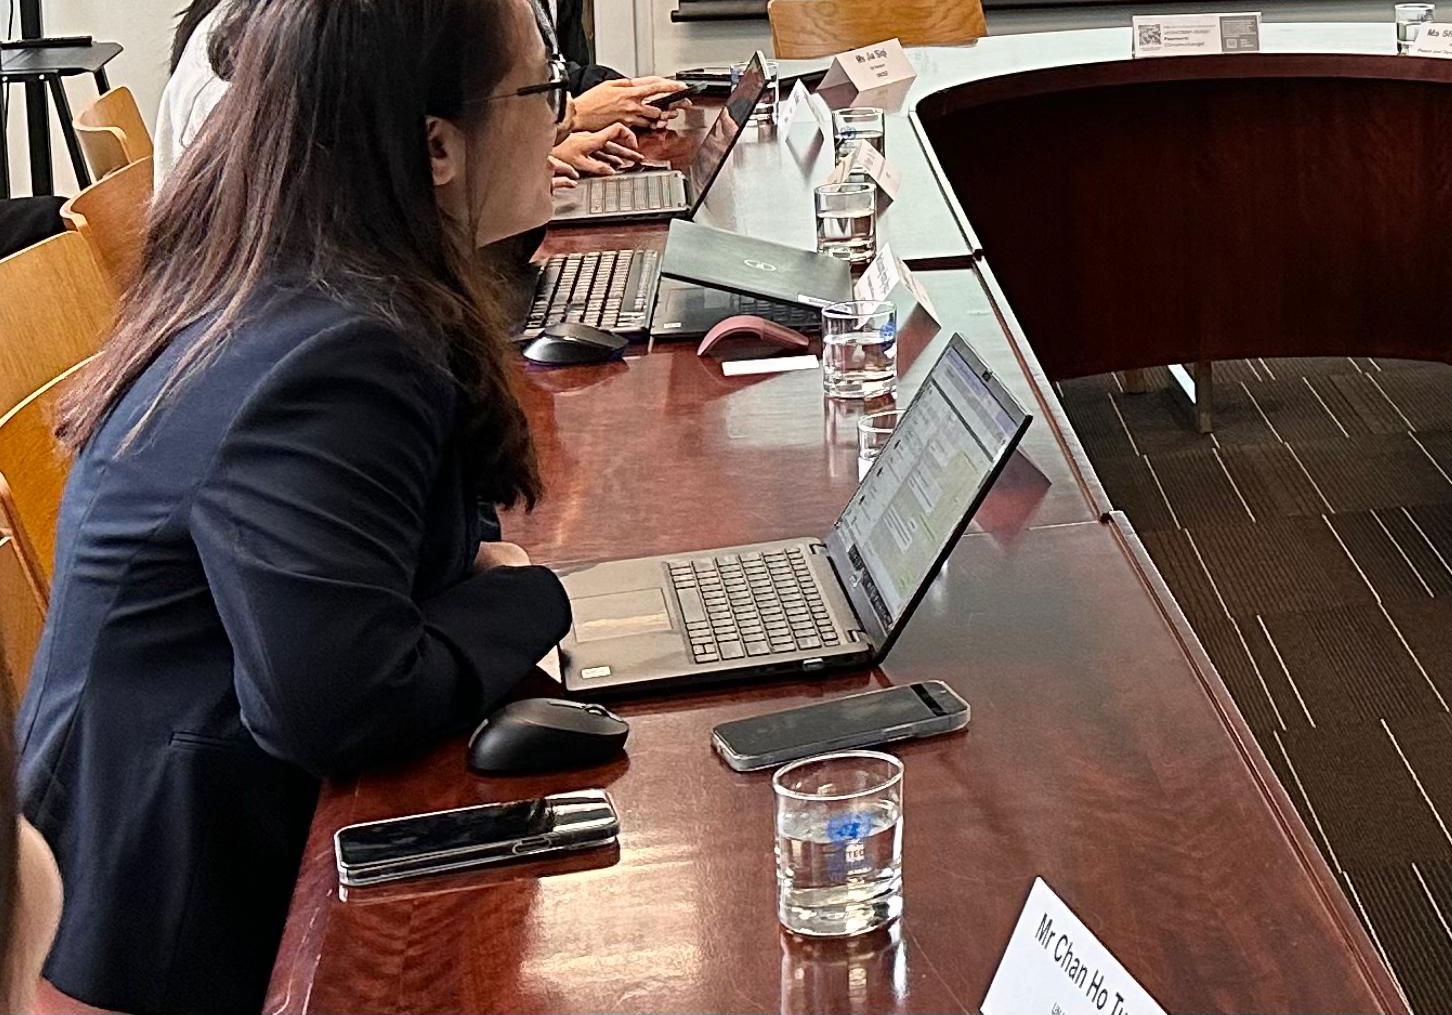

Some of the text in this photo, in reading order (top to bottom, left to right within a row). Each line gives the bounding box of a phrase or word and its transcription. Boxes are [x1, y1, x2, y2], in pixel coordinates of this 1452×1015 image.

[1034, 912, 1056, 950] Mr
[1053, 934, 1088, 989] Chan
[1085, 968, 1109, 1011] Ho
